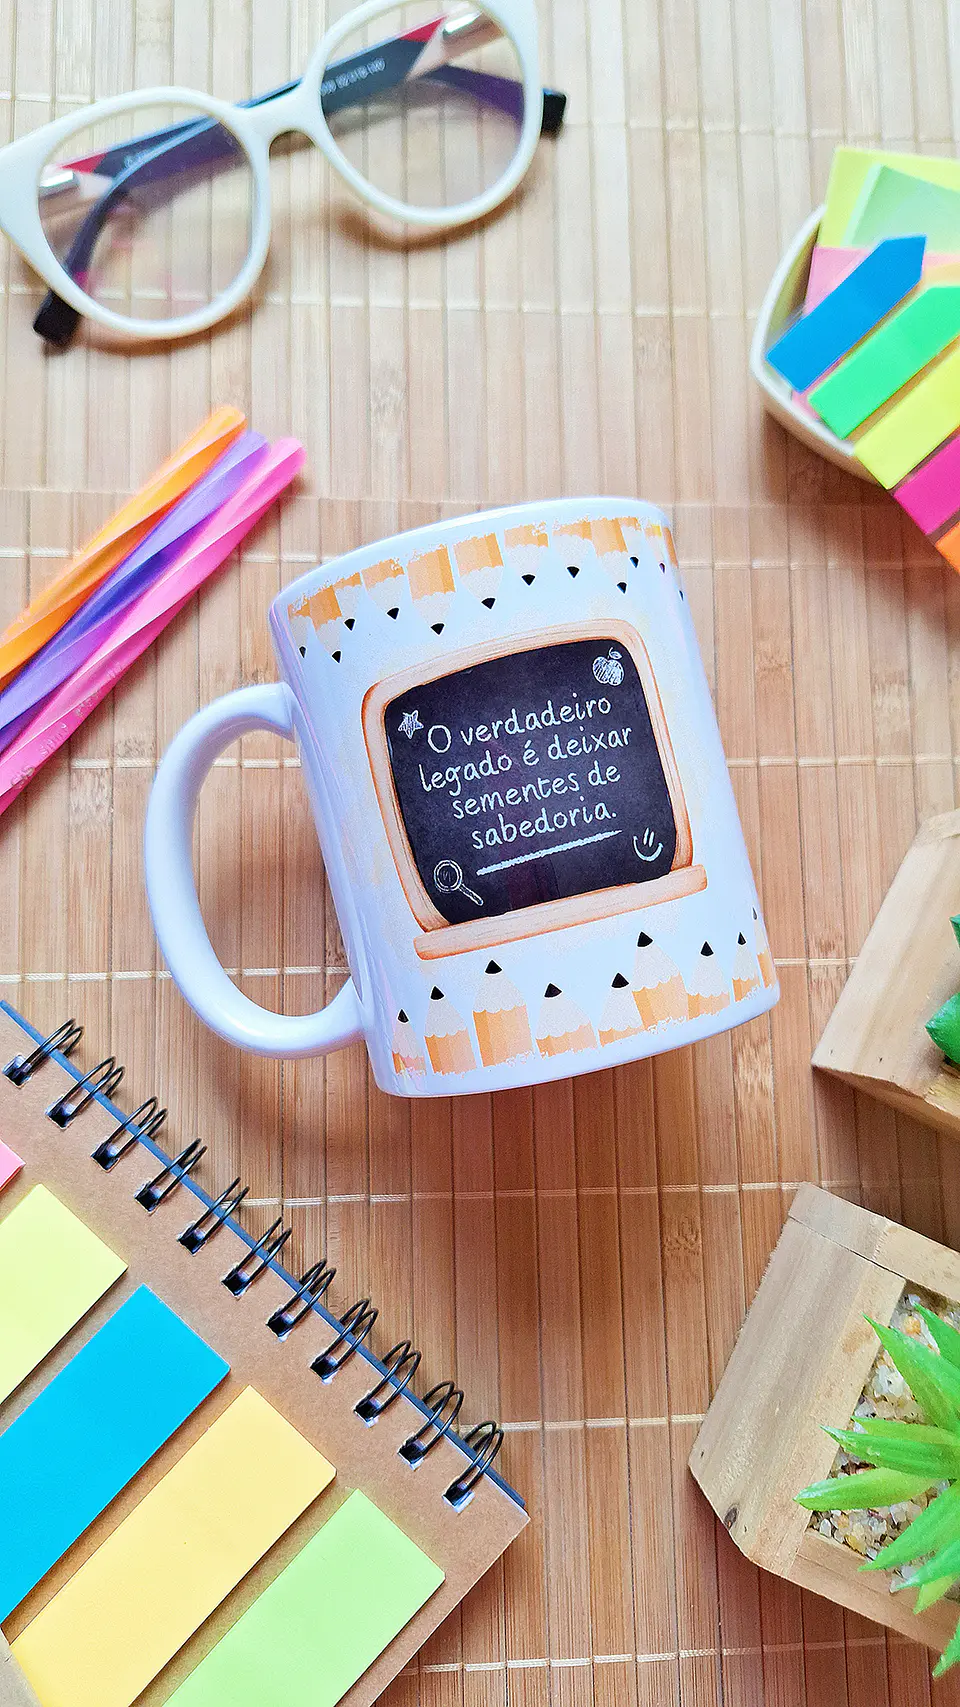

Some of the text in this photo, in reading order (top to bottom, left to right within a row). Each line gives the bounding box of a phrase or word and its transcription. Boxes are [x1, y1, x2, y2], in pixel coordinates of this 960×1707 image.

[427, 692, 611, 753] O verdadeiro
[418, 726, 632, 796] legado é deixar
[452, 761, 621, 819] sementes de
[471, 796, 617, 850] sabedoria.
